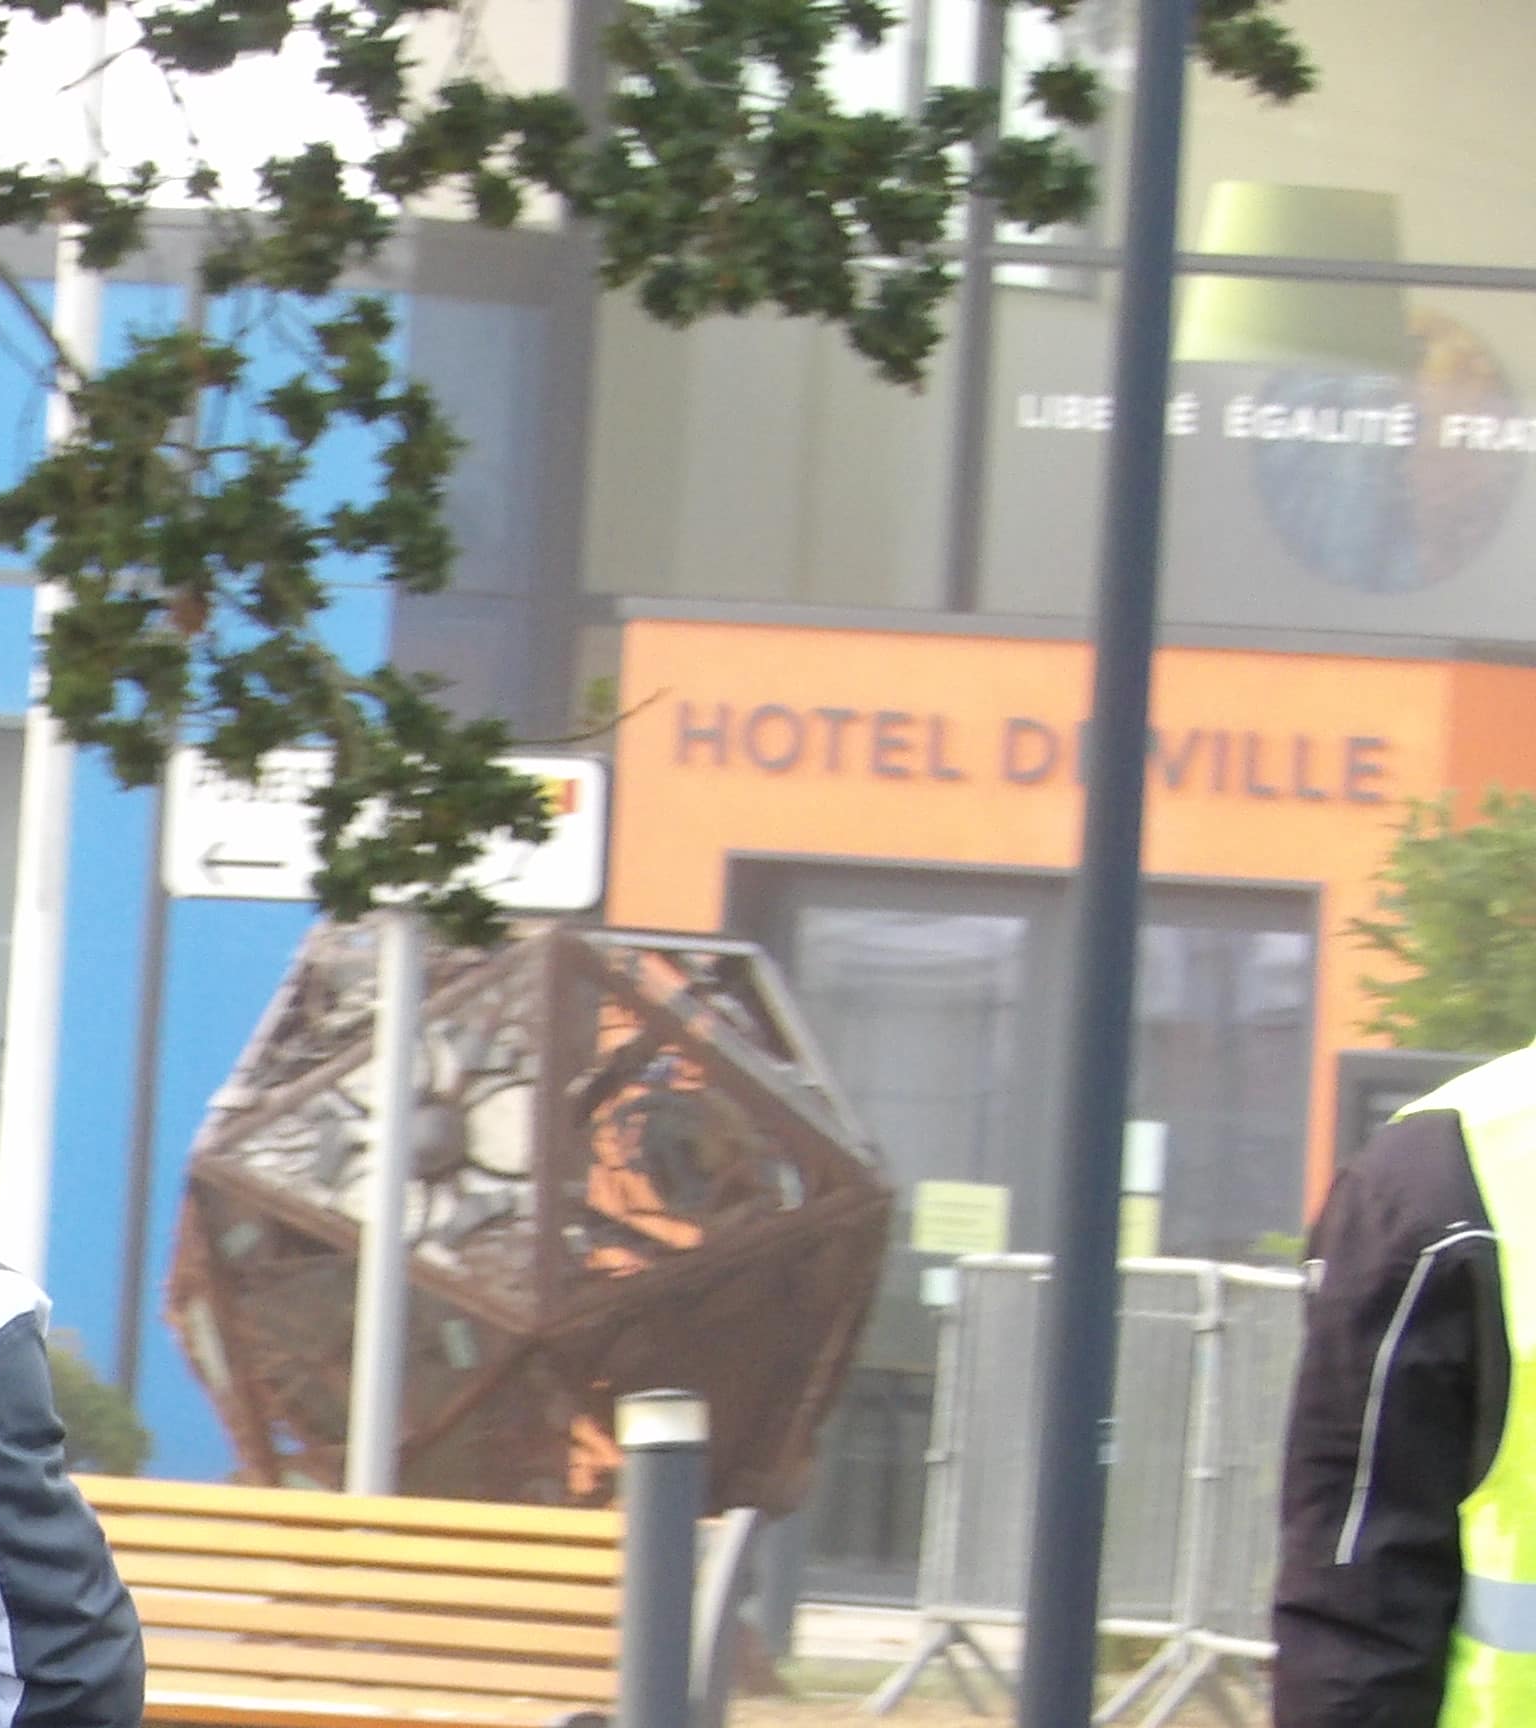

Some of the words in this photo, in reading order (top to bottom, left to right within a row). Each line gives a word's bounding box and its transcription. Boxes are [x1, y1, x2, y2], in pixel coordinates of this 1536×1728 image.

[1018, 391, 1200, 436] LIBEÉ
[1223, 395, 1416, 446] ÉGALITÉ
[674, 700, 963, 782] HOTEL
[1144, 726, 1388, 803] VILLE
